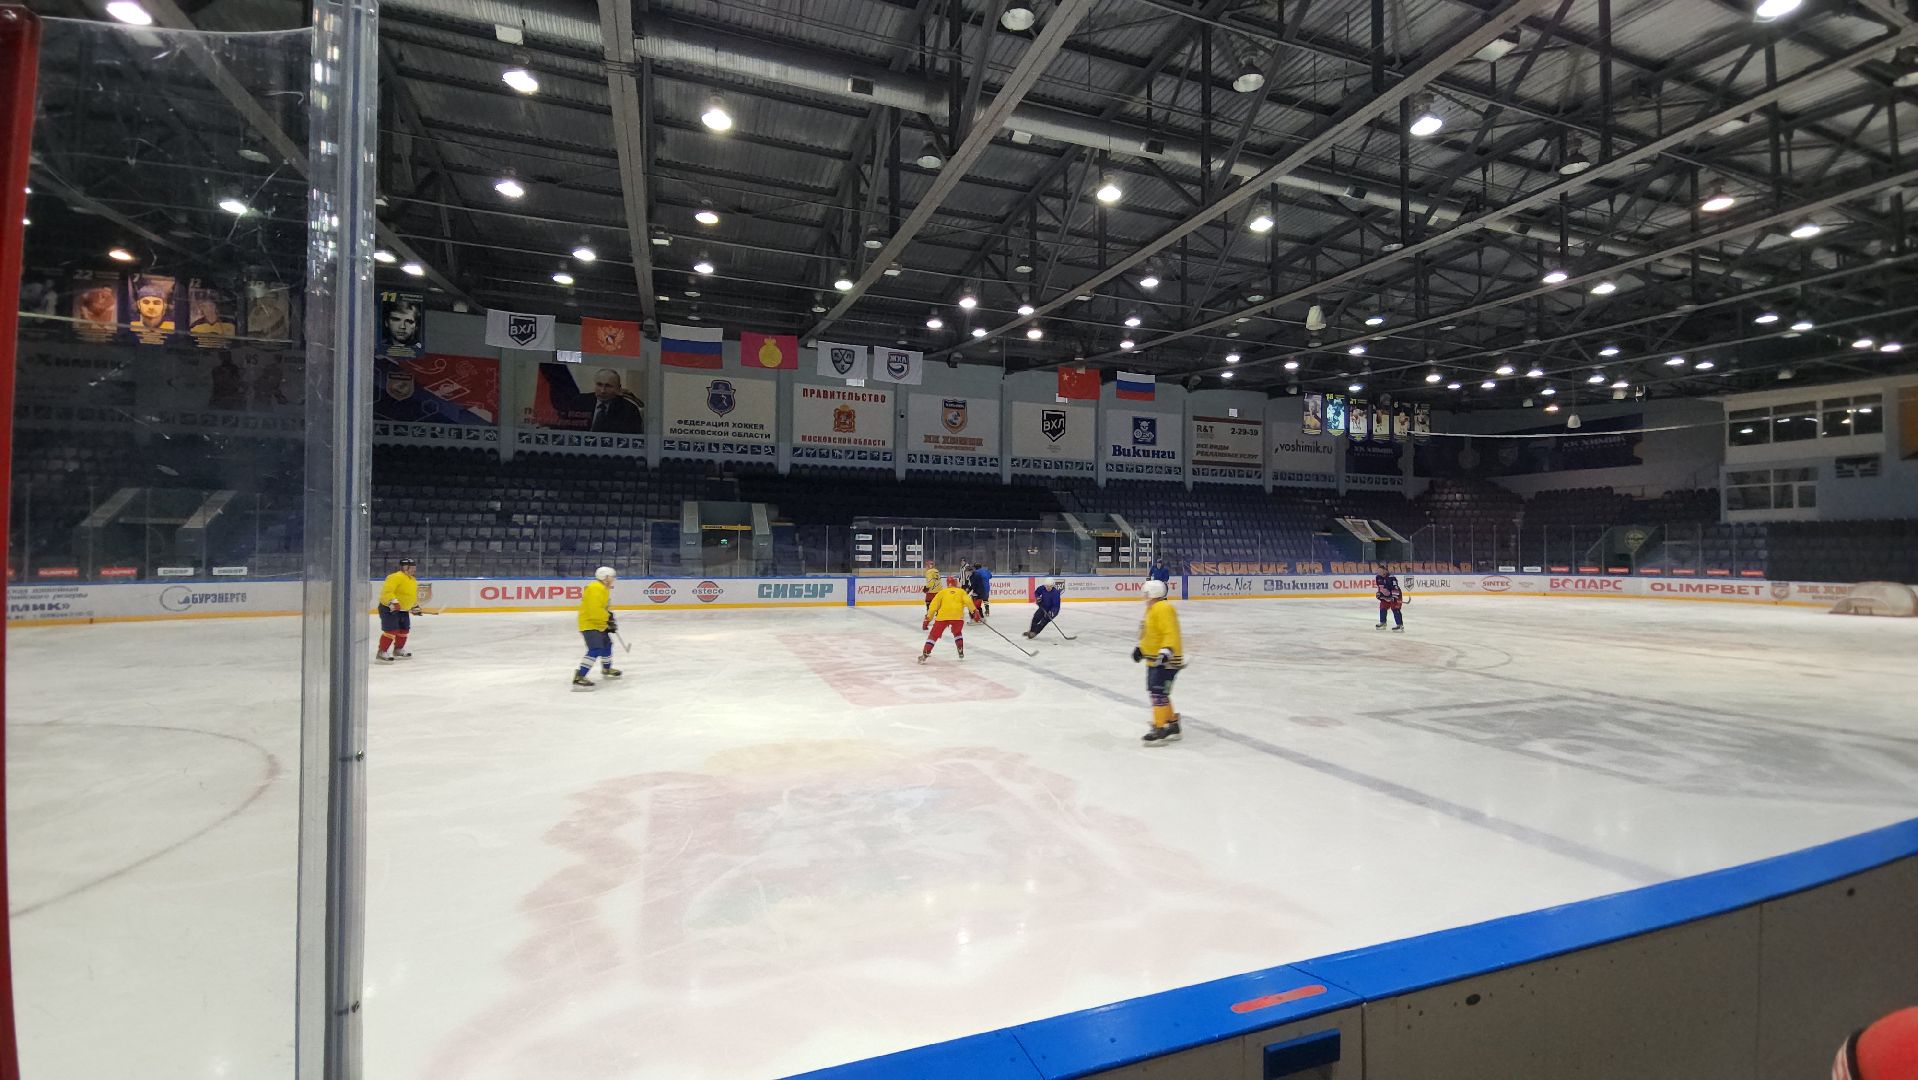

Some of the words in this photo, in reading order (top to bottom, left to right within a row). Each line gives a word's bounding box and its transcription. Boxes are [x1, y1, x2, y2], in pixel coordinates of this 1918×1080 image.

[510, 324, 536, 335] ВХЛ
[802, 388, 886, 404] ПРАВИТЕЛЬСТВО
[677, 419, 729, 428] ФЕДЕРАЦИЯ
[732, 422, 764, 431] ХОККЕЯ
[1043, 418, 1066, 432] ВХЛ
[1196, 424, 1214, 433] R&T
[669, 427, 729, 437] МОСКОВСКОЙ
[732, 431, 771, 440] ОБЛАСТИ
[801, 434, 851, 445] МОСКОВСКОЙ
[852, 437, 886, 447] ОБЛАСТИ
[1111, 445, 1176, 460] Викинги
[1279, 440, 1333, 455] voshimik.ru
[692, 587, 724, 595] esteco
[757, 583, 834, 599] СИБУР
[1275, 579, 1329, 591] Викинги
[1332, 579, 1378, 590] OLIMPB
[1650, 582, 1764, 596] OLIMPBET
[192, 592, 247, 604] БУРЭНЕРГО
[480, 586, 614, 600] OLIMPB
[643, 587, 677, 596] esteco
